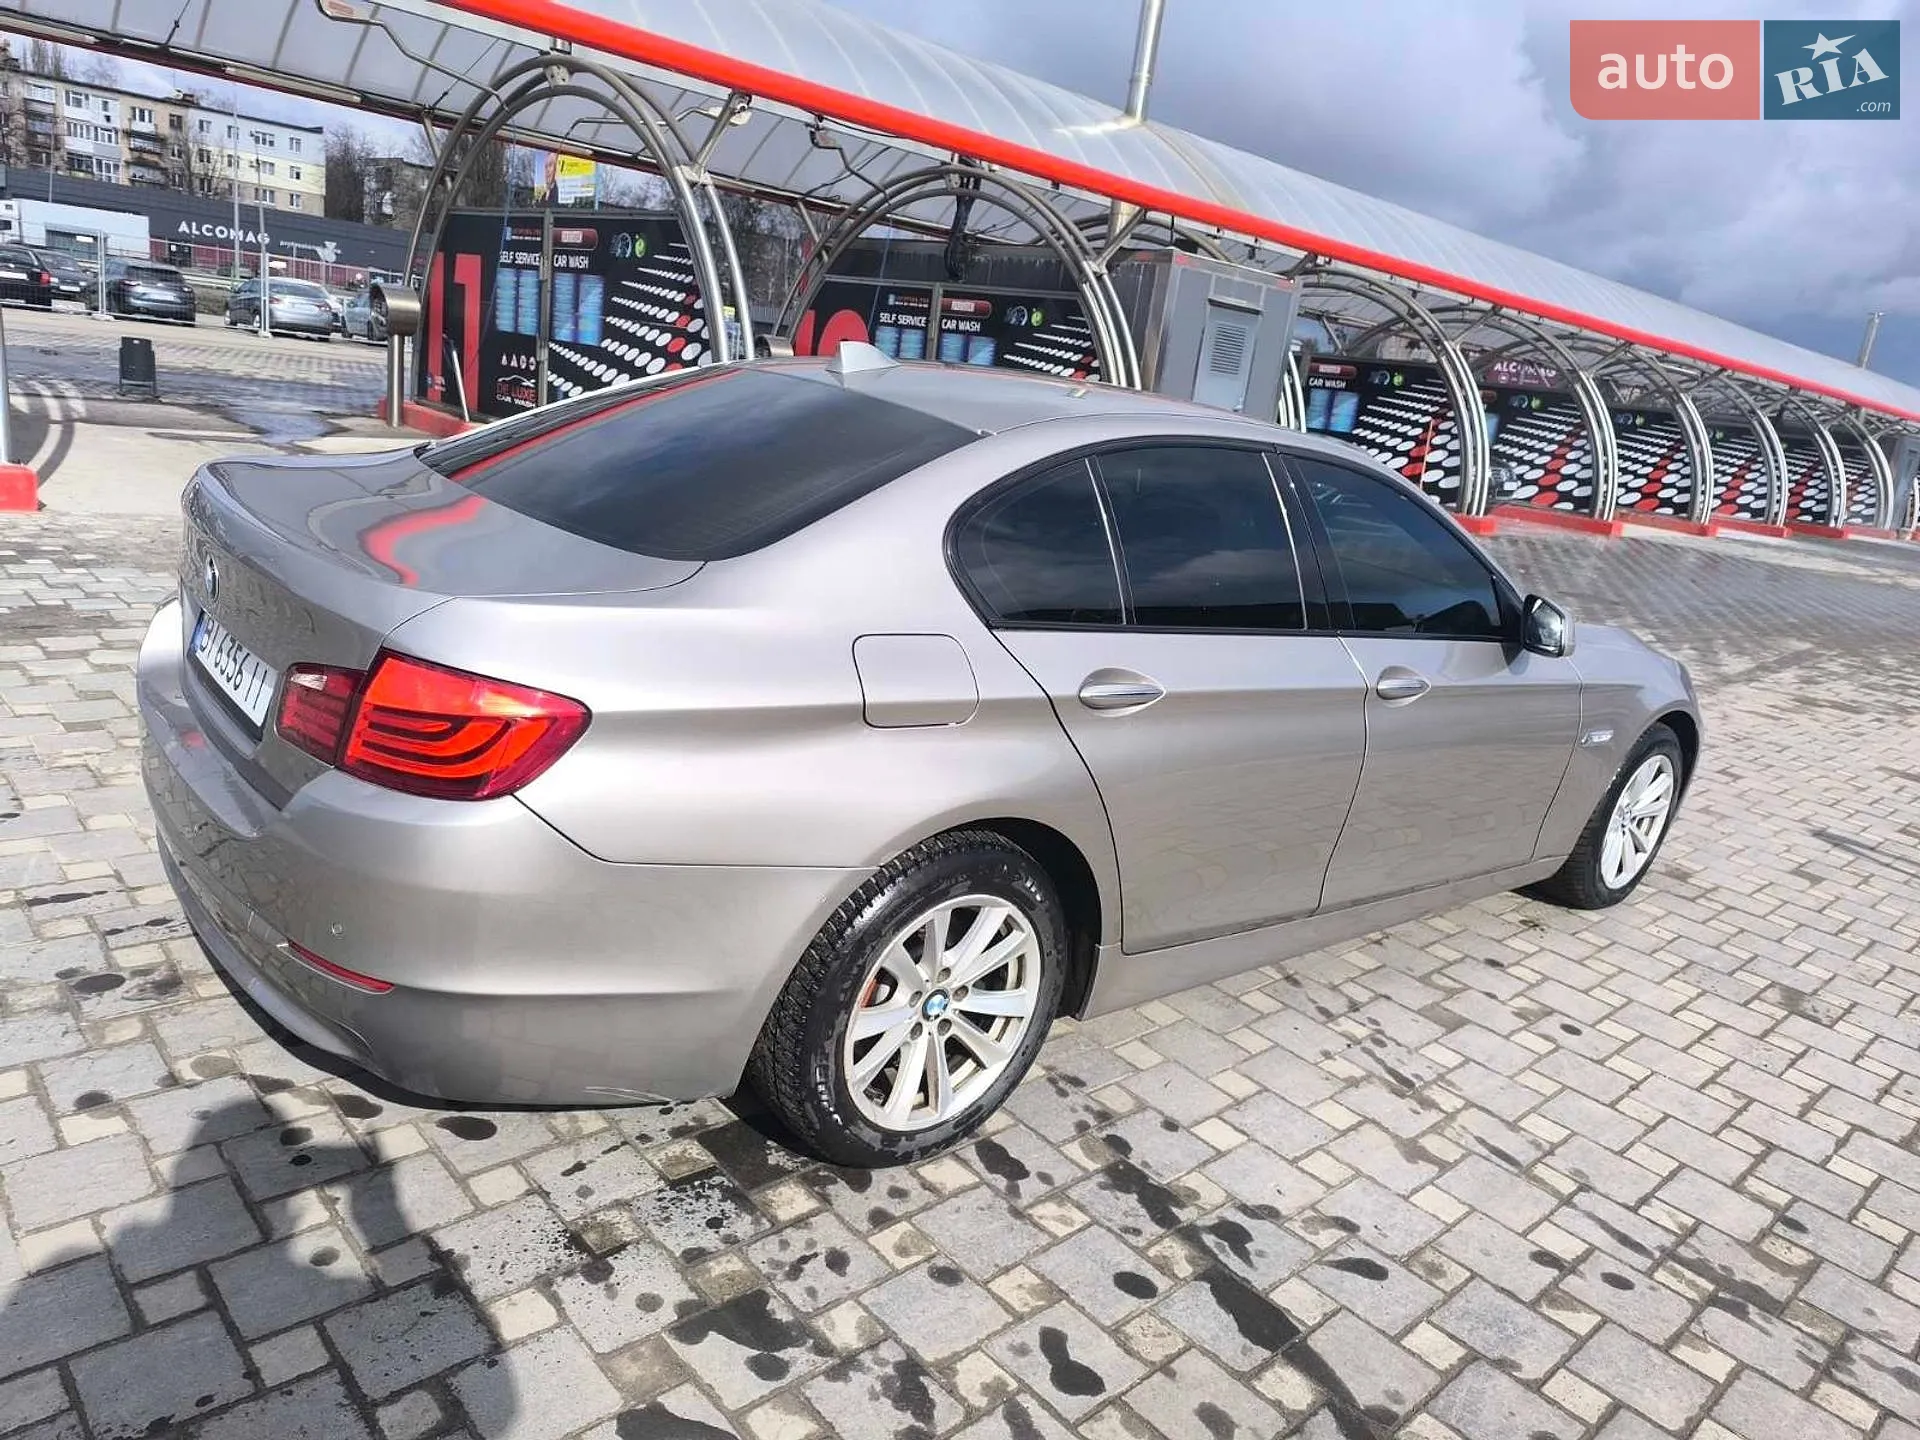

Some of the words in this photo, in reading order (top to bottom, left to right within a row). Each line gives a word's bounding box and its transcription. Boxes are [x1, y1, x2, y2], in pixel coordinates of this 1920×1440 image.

[178, 220, 270, 245] ALCOMAG
[500, 251, 514, 263] SELF
[515, 252, 540, 265] SERVICE
[554, 254, 567, 267] CAR
[569, 255, 589, 269] WASH
[879, 312, 896, 324] SELF
[898, 314, 927, 327] SERVICE
[942, 318, 957, 330] CAR
[958, 320, 981, 332] WASH
[1309, 377, 1323, 386] CAR
[1325, 379, 1346, 389] WASH
[214, 632, 250, 691] 6356
